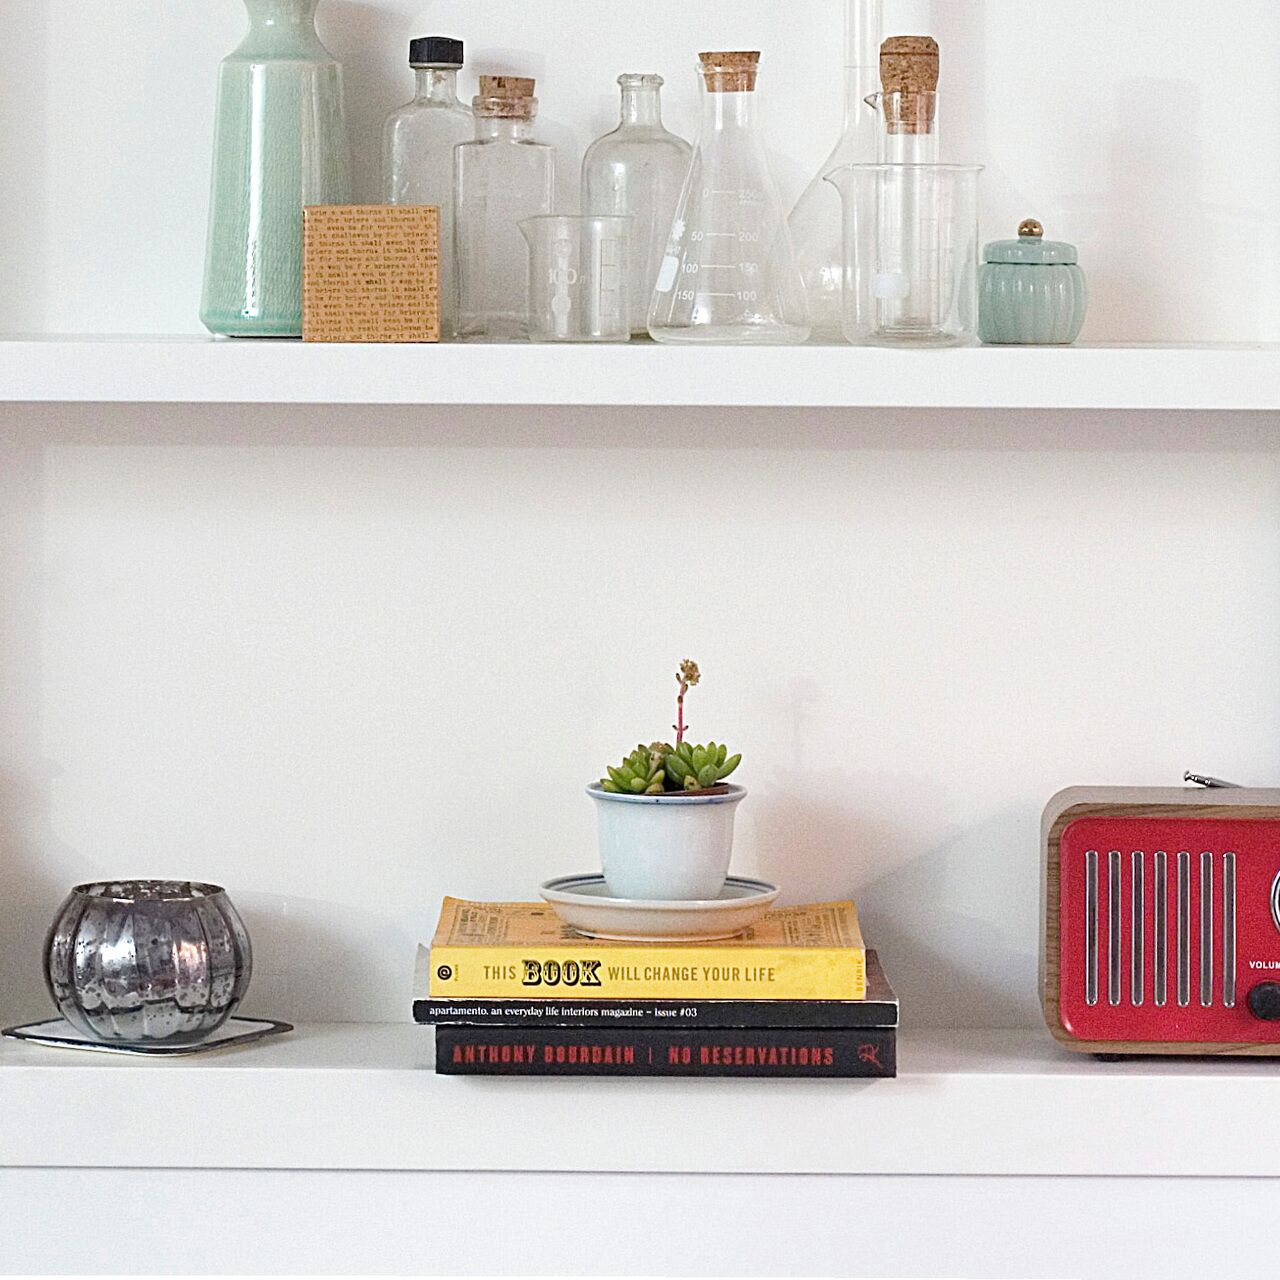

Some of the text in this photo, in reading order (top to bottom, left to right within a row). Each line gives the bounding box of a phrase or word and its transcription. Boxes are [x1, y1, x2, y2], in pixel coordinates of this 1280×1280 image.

[691, 231, 759, 241] 50 200
[681, 263, 699, 274] 100
[677, 290, 757, 301] 150 100
[484, 959, 776, 986] THIS BOOK WILL CHANGE YOUR LIFE
[491, 1008, 503, 1016] an
[505, 1007, 543, 1018] everyday
[546, 1006, 559, 1016] life
[561, 1007, 599, 1017] interiors
[601, 1007, 644, 1018] magazine
[654, 1008, 677, 1017] issue
[680, 1008, 698, 1017] #03
[453, 1045, 634, 1064] ANTHONY BOURDAIN
[669, 1046, 834, 1065] NO RESERVATIONS
